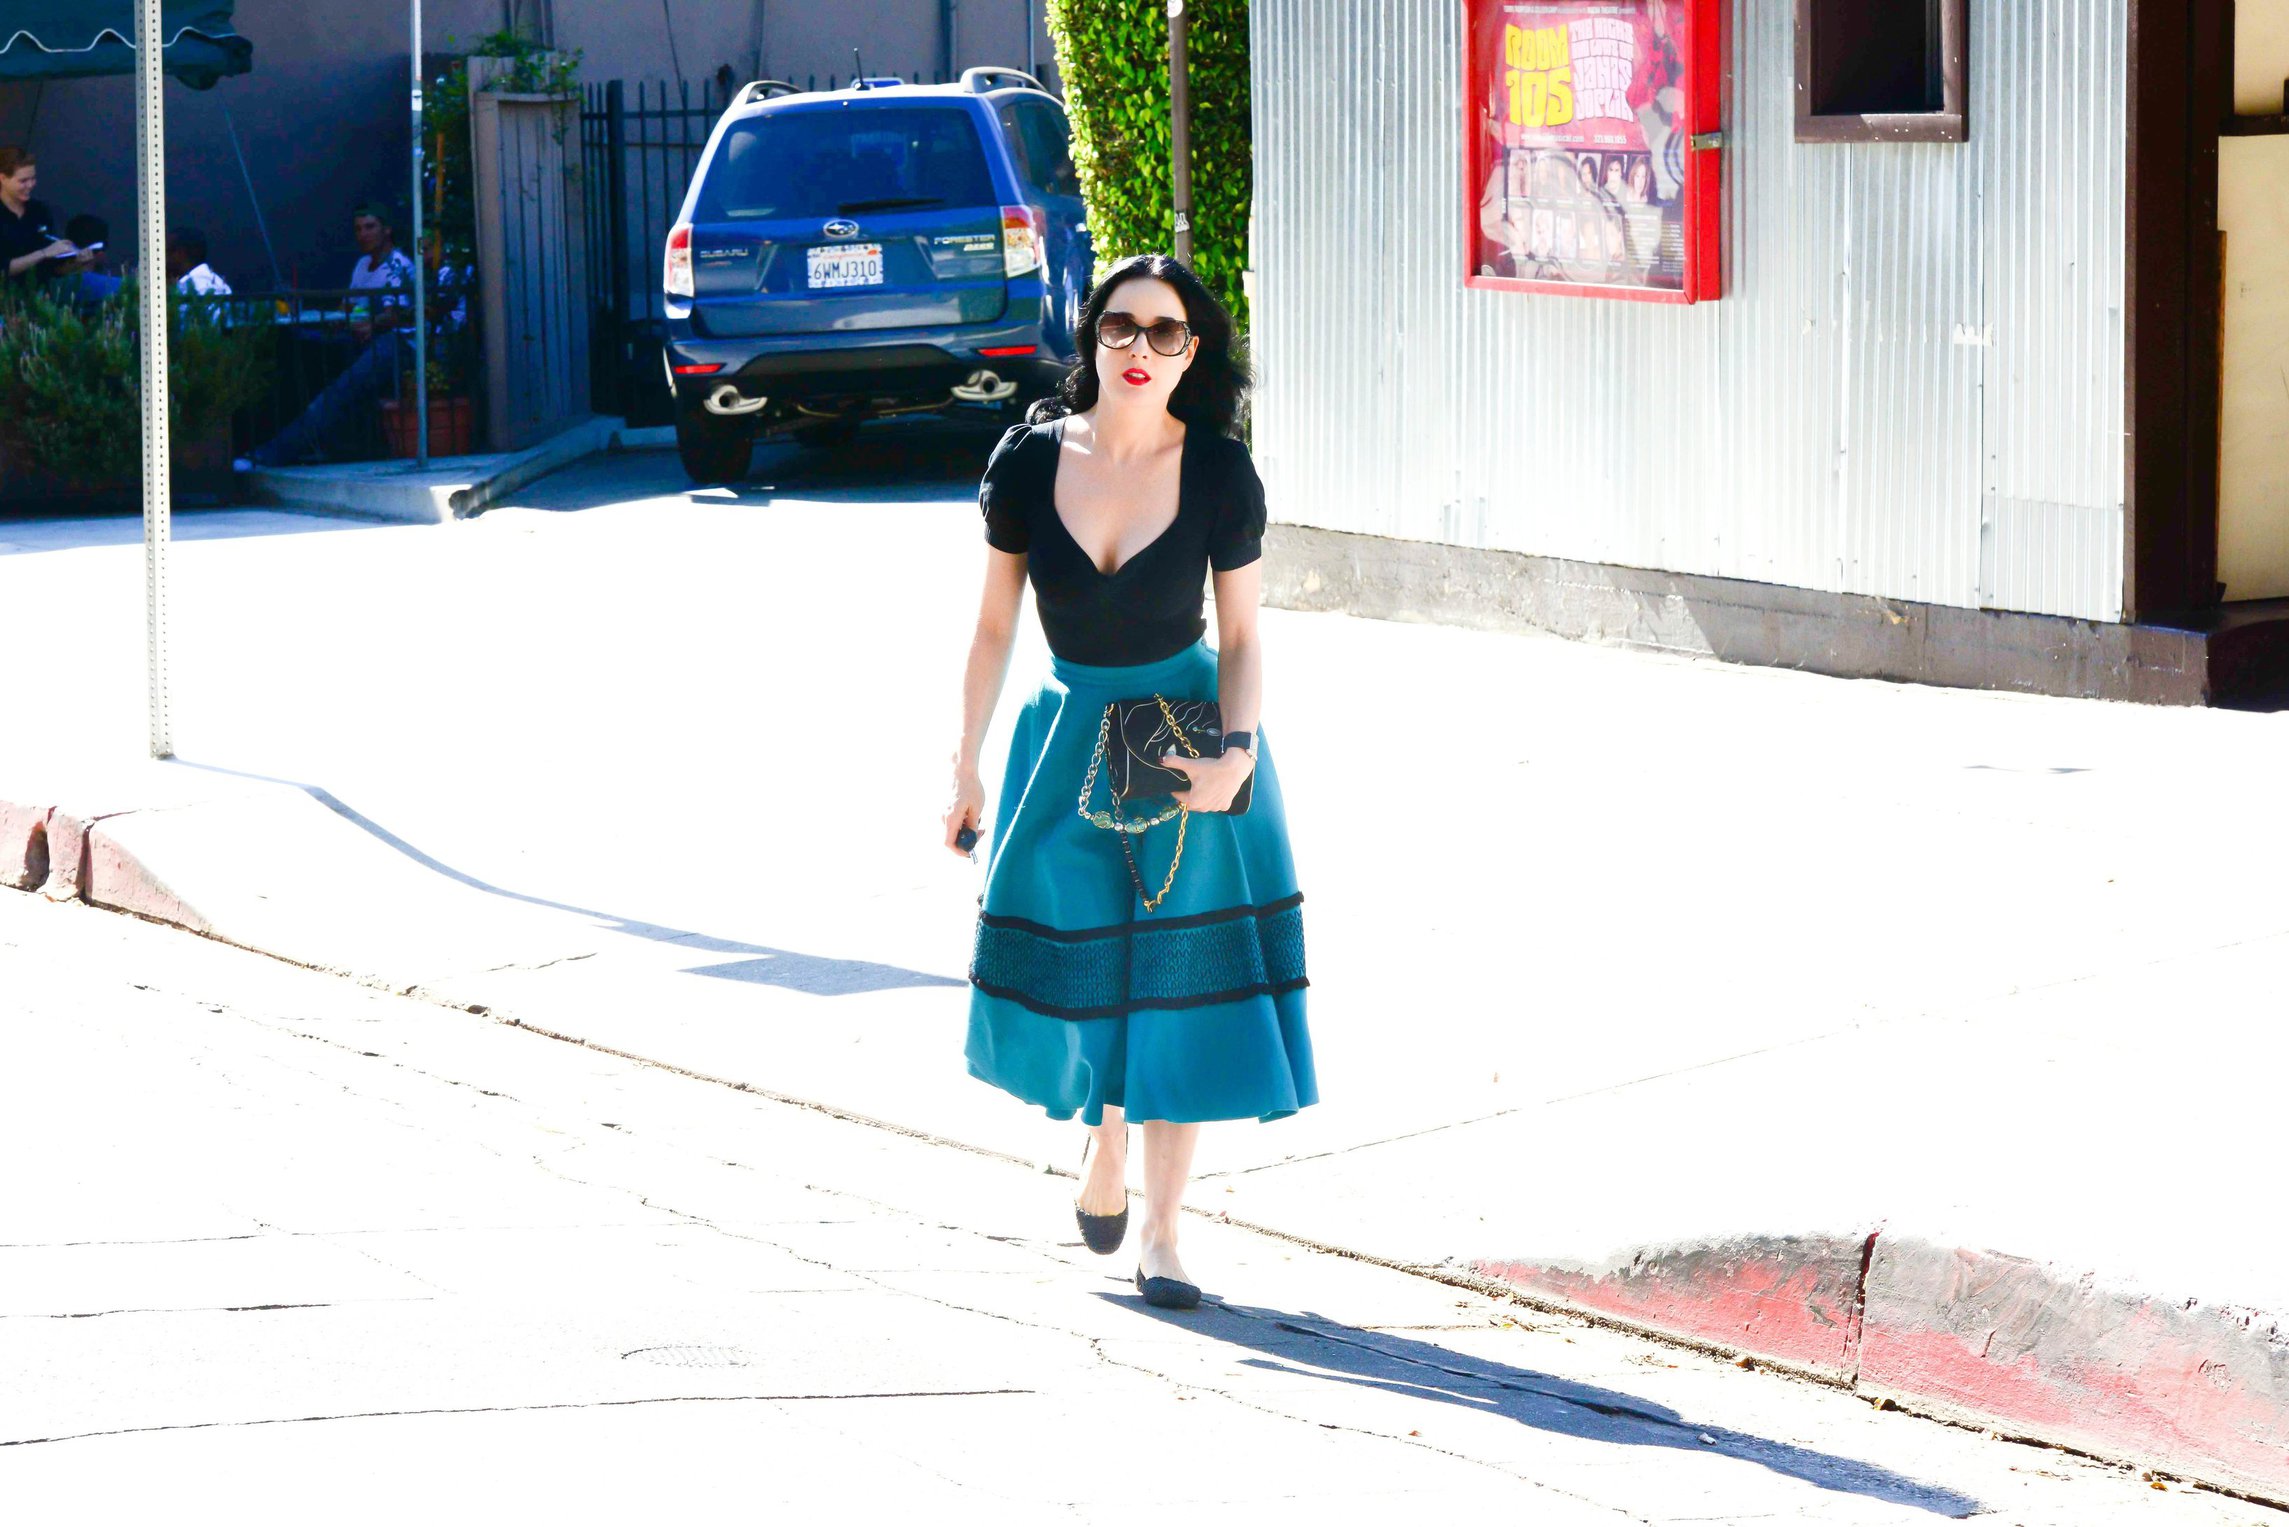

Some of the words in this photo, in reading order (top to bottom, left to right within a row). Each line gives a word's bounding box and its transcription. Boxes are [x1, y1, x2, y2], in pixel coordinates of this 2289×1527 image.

[1505, 23, 1569, 72] ROOM
[1505, 68, 1573, 128] 105
[934, 234, 996, 245] FORESTER
[700, 248, 749, 258] SUBARU
[814, 260, 877, 280] 6WMJ310
